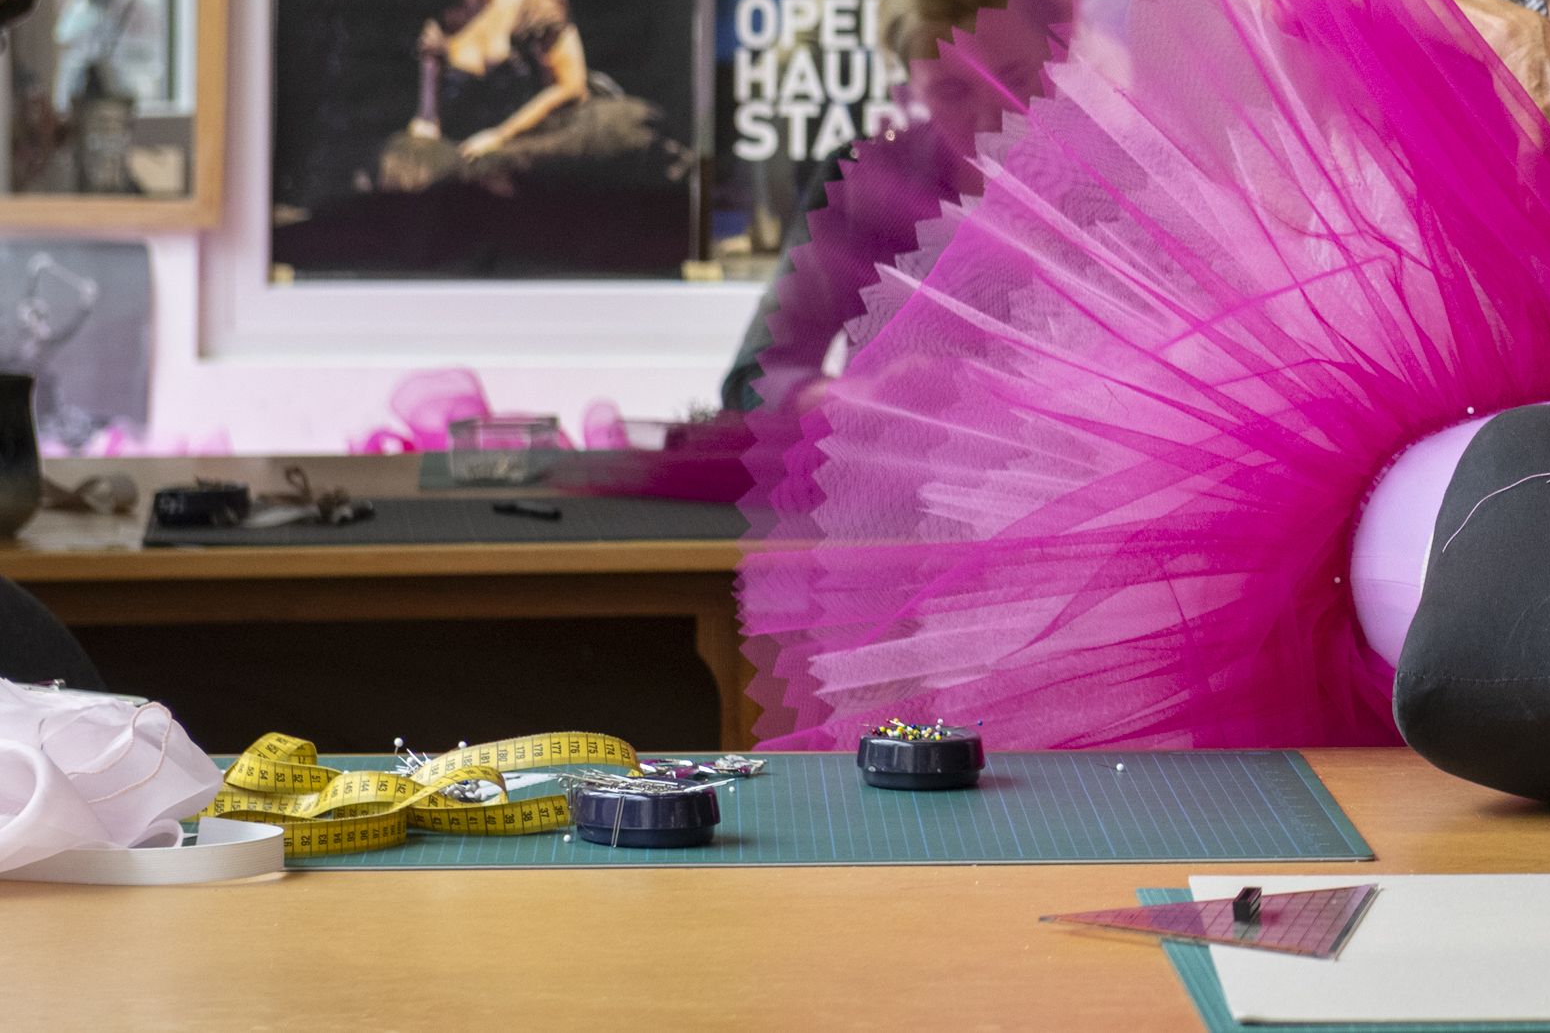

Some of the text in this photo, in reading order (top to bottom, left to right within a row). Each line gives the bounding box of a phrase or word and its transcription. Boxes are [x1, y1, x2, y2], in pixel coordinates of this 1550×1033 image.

[516, 746, 526, 759] 179
[534, 743, 543, 757] 178
[552, 742, 561, 754] 177
[570, 740, 580, 754] 176
[588, 742, 598, 754] 175
[606, 744, 615, 755] 174
[480, 752, 490, 764] 181
[498, 749, 508, 762] 180
[260, 770, 268, 780] 54
[276, 772, 286, 782] 53
[293, 774, 304, 783] 52
[378, 780, 388, 792] 143
[505, 814, 514, 824] 39
[523, 810, 533, 822] 38
[540, 808, 550, 818] 37
[469, 816, 478, 824] 41
[486, 815, 496, 825] 40
[300, 836, 311, 846] 92
[318, 834, 328, 845] 93
[334, 832, 342, 844] 94
[346, 830, 356, 842] 95
